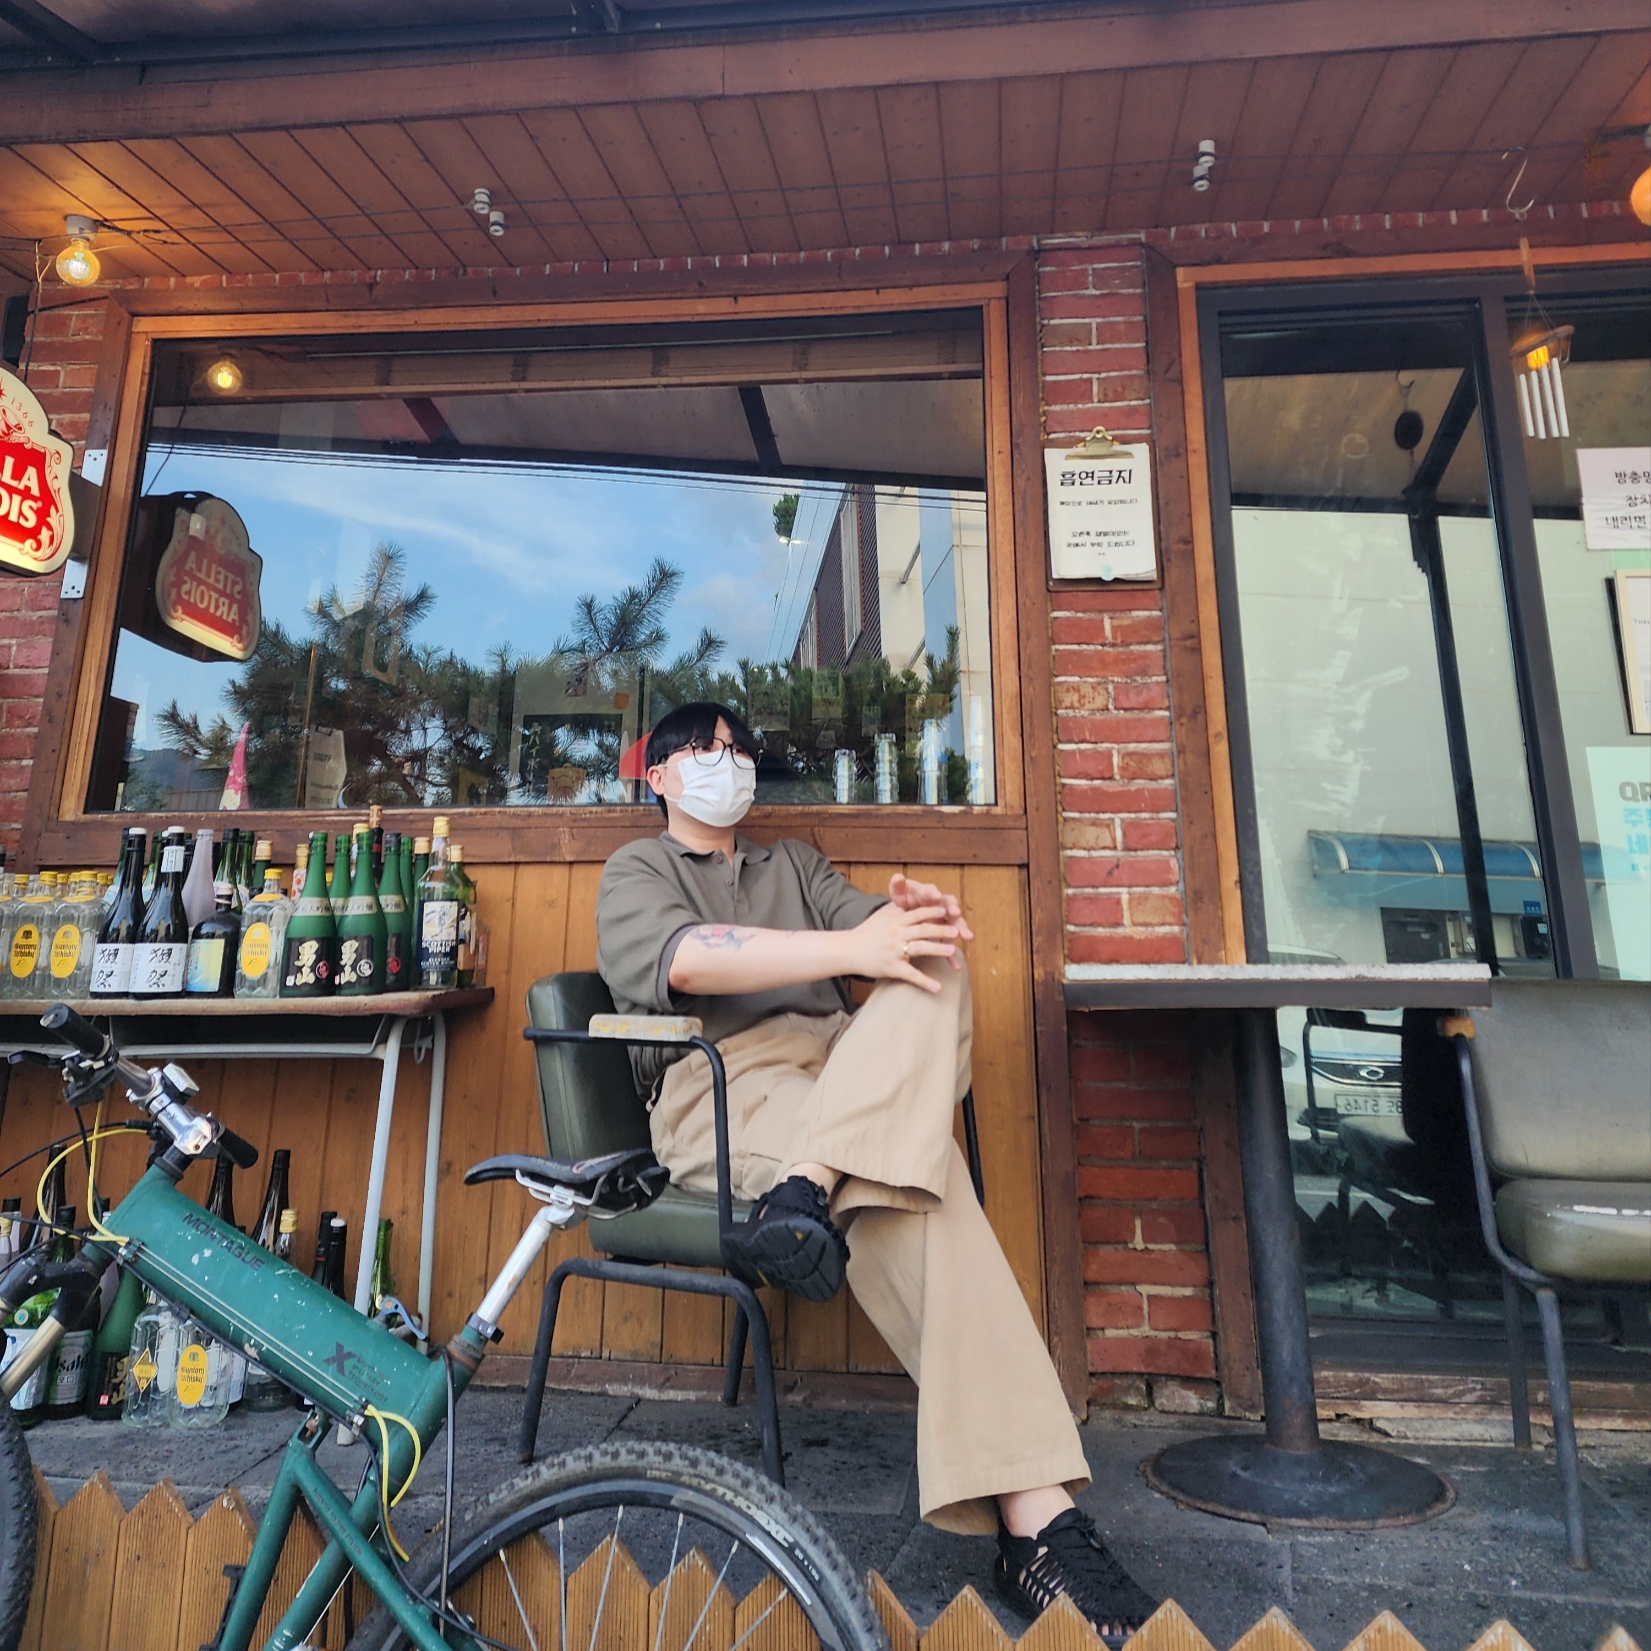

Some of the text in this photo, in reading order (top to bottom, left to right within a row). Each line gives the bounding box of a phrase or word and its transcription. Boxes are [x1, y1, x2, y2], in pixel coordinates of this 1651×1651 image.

[11, 397, 35, 428] 1366
[0, 455, 41, 497] LA
[1060, 468, 1133, 487] 흡연금지
[1605, 515, 1647, 529] 내리면
[1623, 807, 1651, 828] 주
[14, 943, 37, 952] Suntory
[182, 1211, 266, 1272] MONTAGUE
[180, 1366, 205, 1375] Suntory
